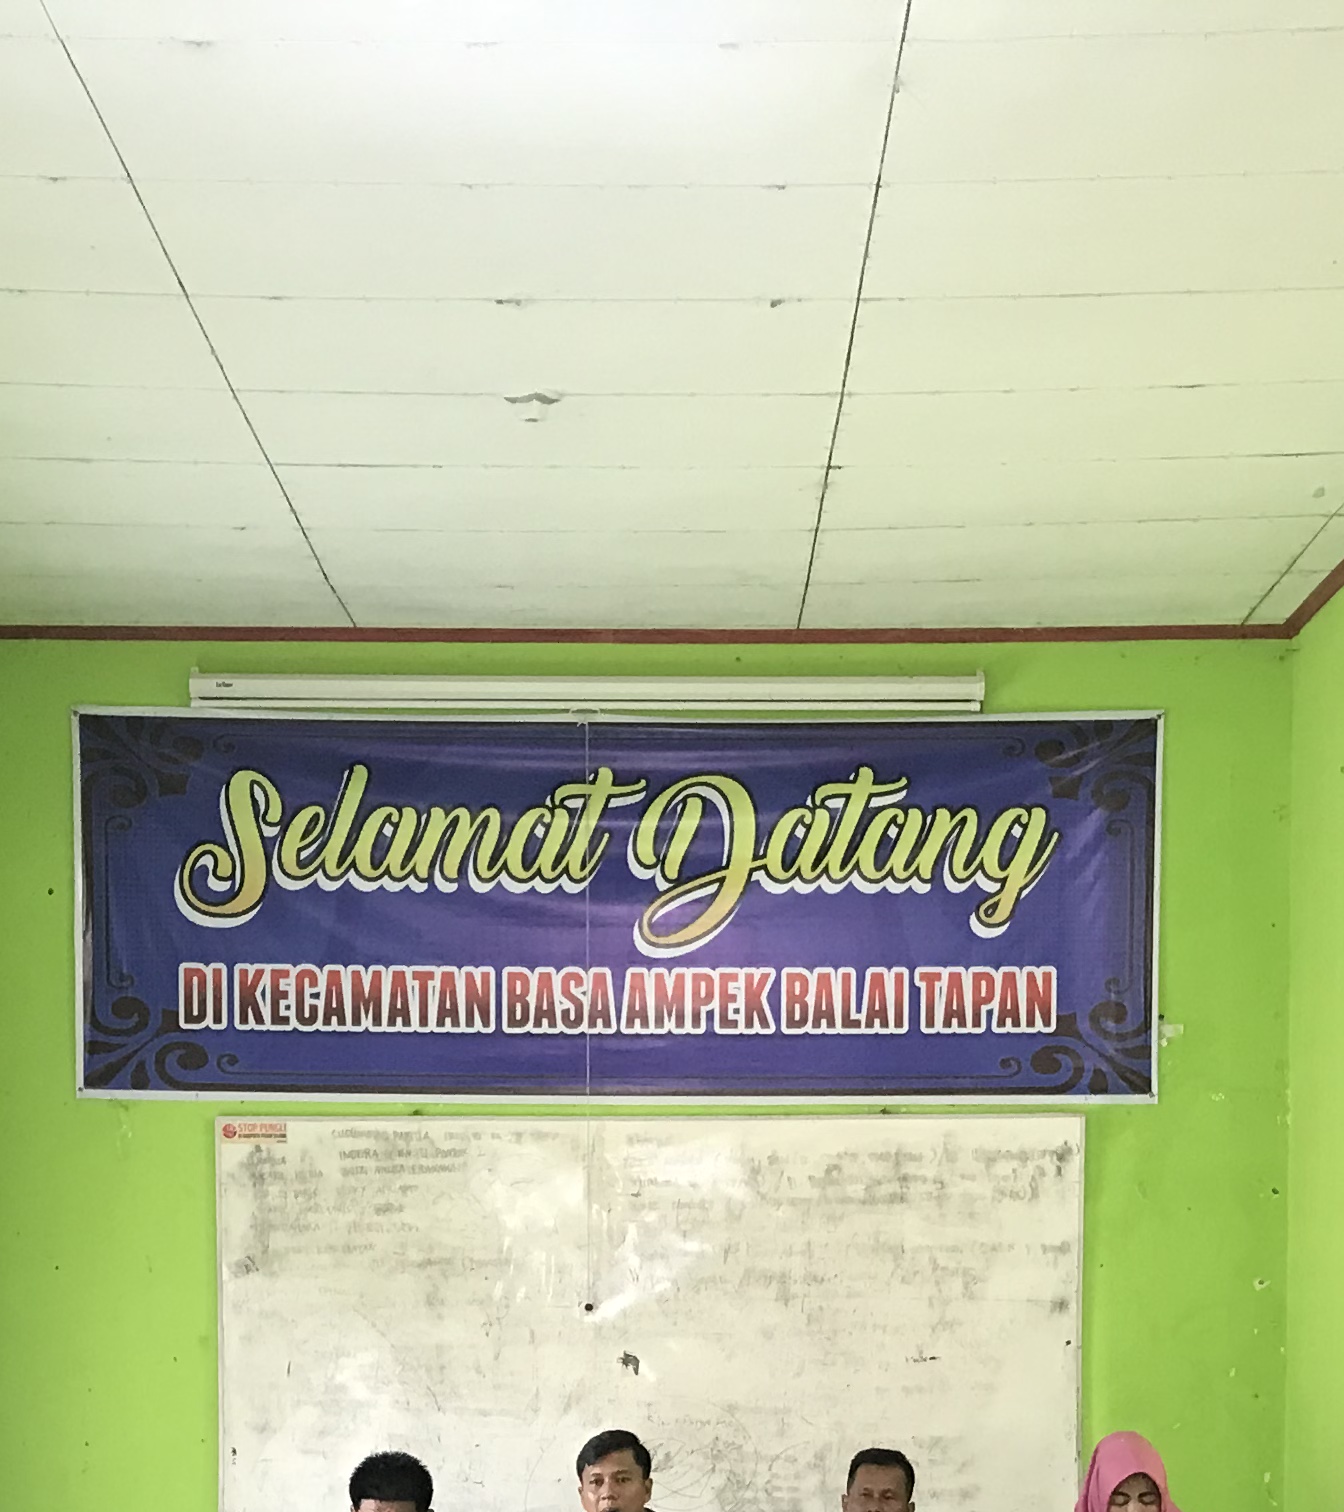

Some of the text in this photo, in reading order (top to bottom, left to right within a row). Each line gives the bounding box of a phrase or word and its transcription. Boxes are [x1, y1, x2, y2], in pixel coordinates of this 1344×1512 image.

[174, 763, 1060, 959] Selamat Datang
[179, 962, 1057, 1034] DI KECAMATAN BASA AMPEK BALAI TAPAN
